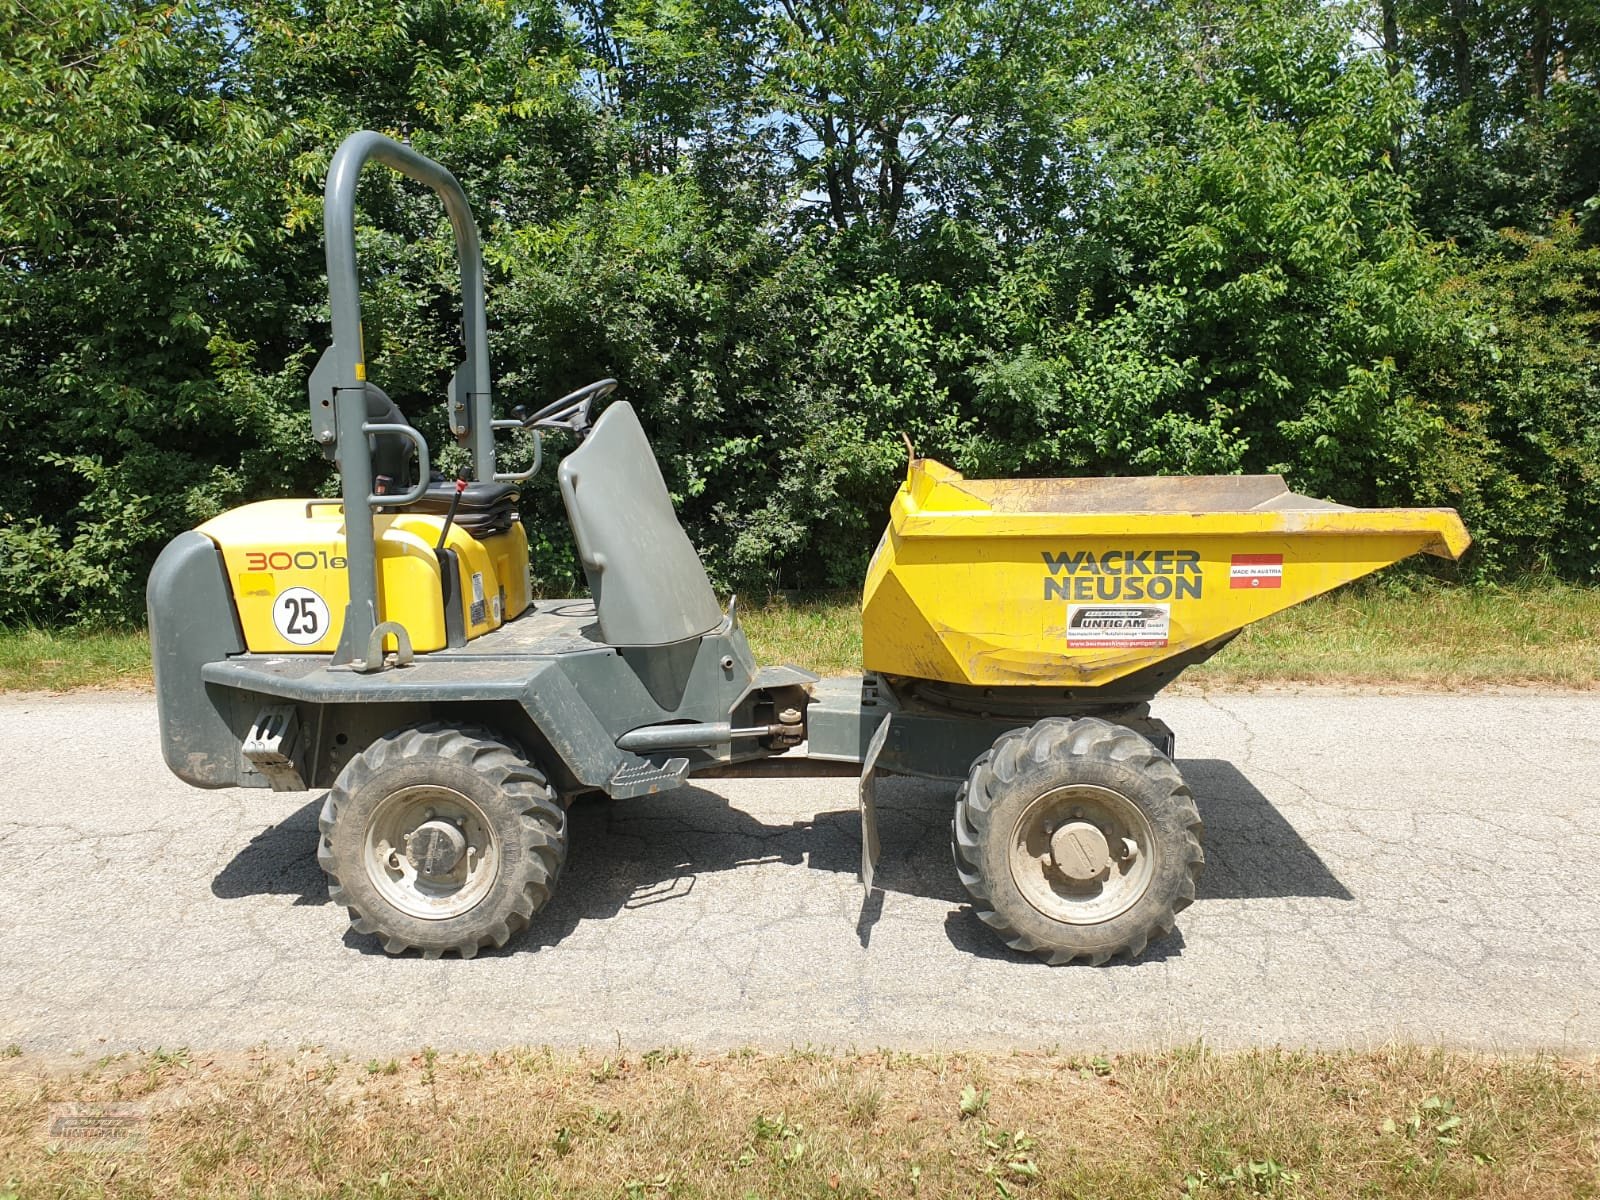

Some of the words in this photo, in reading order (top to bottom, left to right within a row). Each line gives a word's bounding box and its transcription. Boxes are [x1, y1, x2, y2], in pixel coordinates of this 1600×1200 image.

[1041, 550, 1203, 575] WACKER
[1044, 575, 1202, 600] NEUSON
[284, 597, 318, 634] 25
